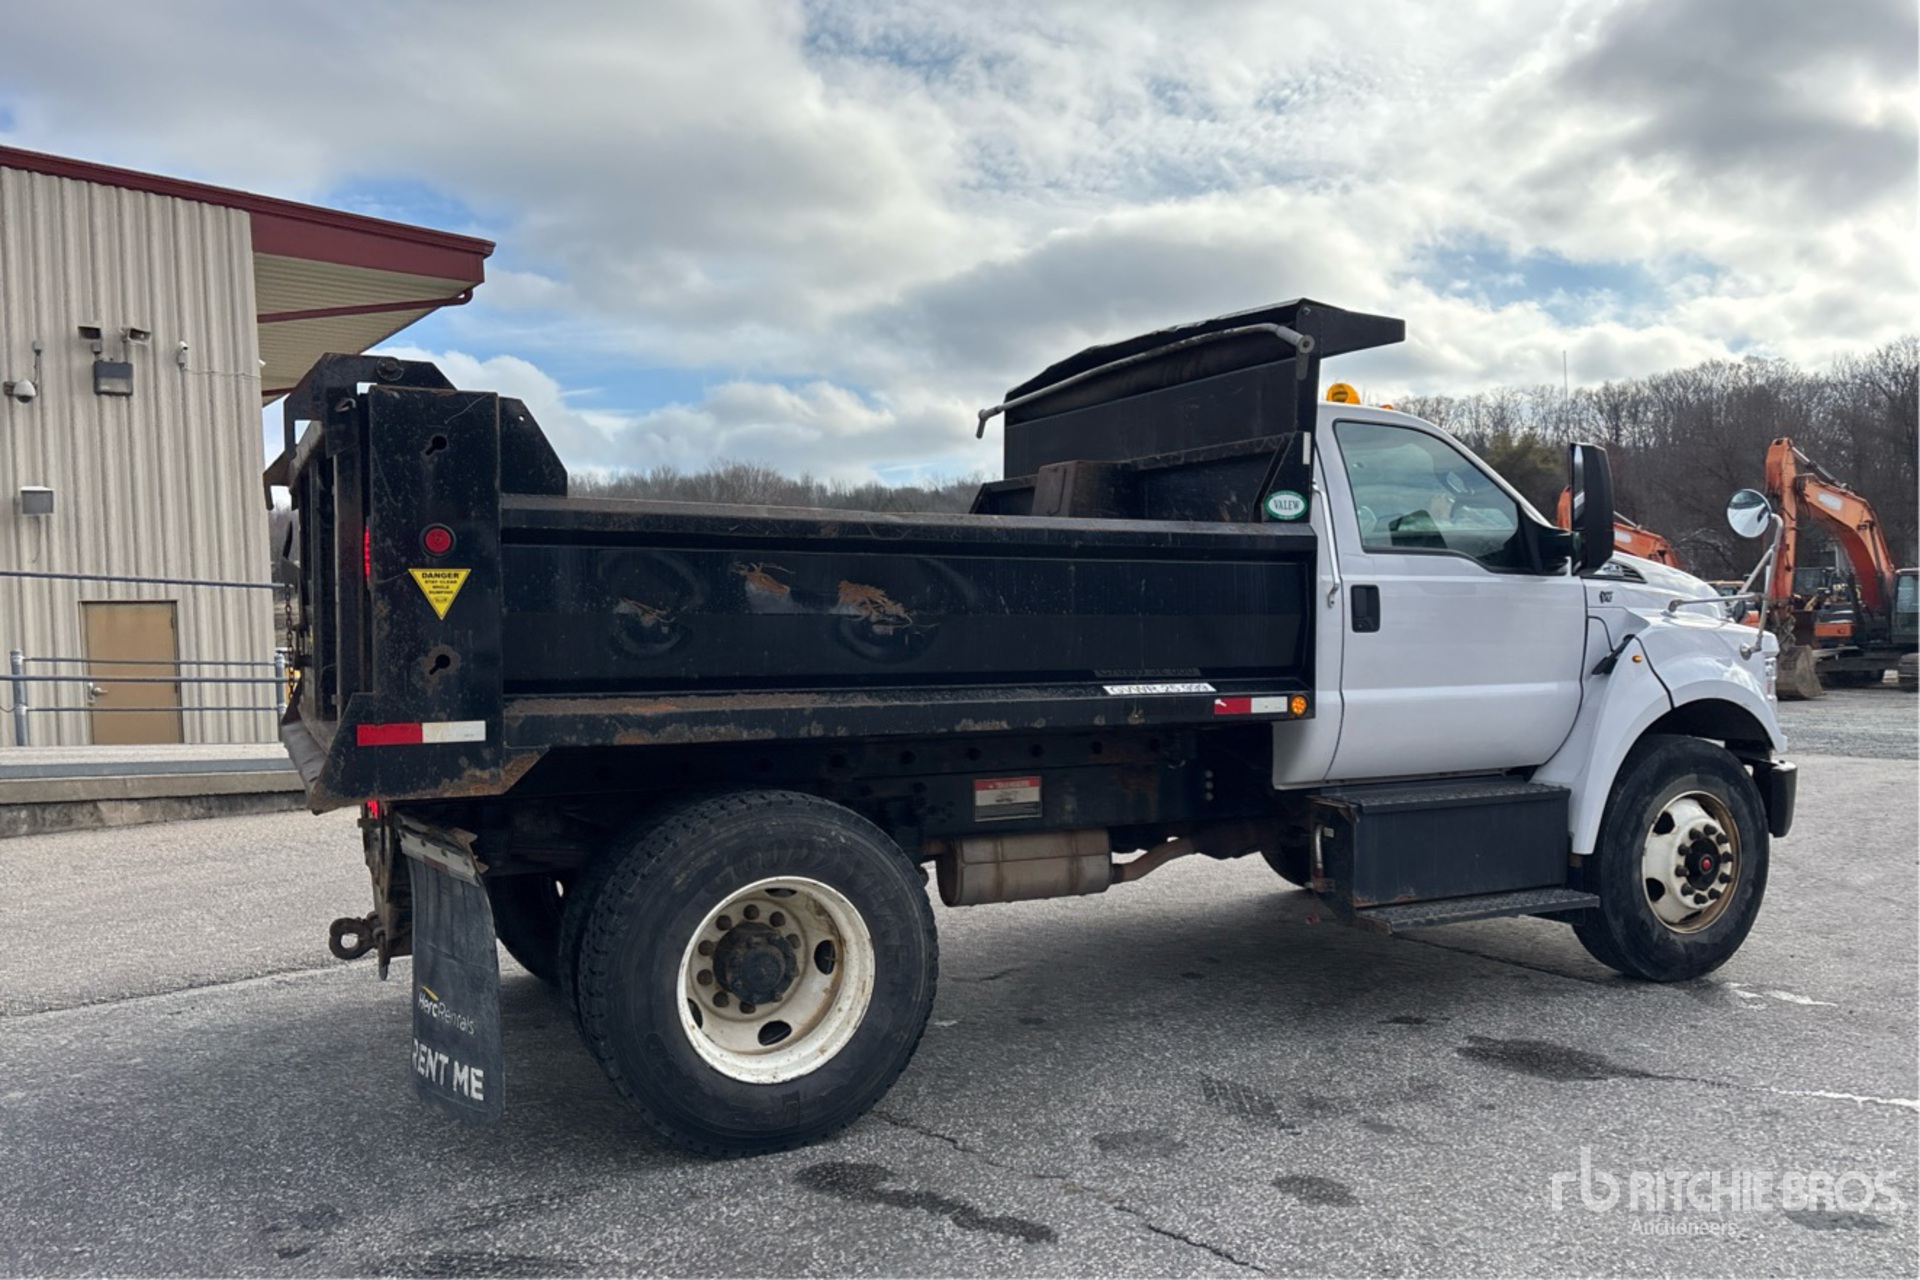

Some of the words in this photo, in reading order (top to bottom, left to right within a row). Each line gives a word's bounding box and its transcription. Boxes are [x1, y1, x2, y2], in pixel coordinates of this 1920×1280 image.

[1273, 499, 1300, 510] VALEW
[412, 1037, 449, 1086] RENT
[453, 1060, 484, 1101] ME
